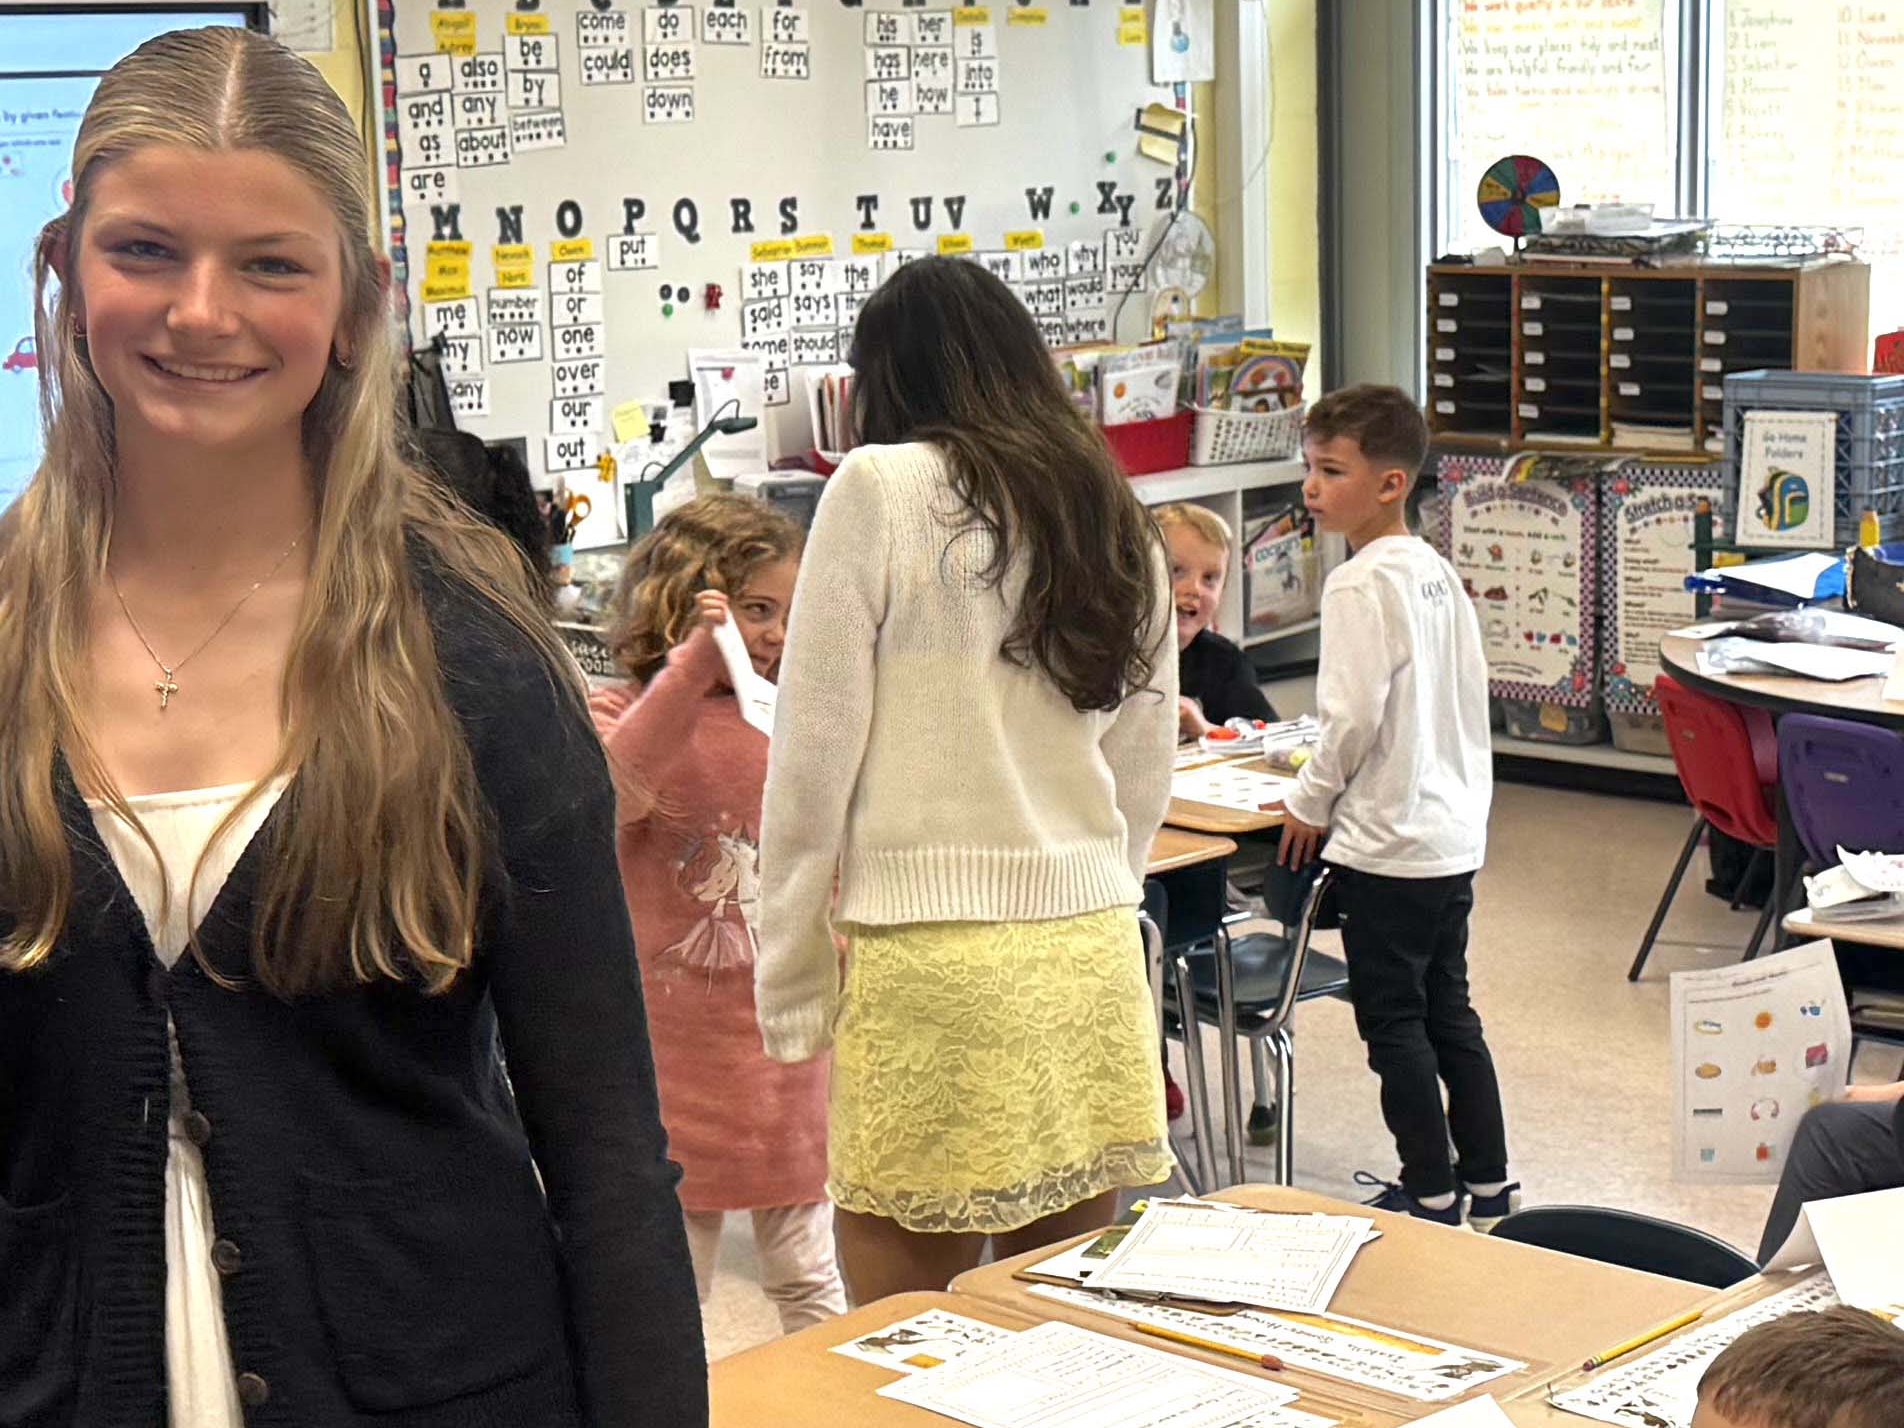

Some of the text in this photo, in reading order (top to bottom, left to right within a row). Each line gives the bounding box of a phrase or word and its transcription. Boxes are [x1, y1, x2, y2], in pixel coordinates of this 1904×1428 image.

[580, 14, 625, 31] come
[659, 11, 679, 29] do
[707, 9, 747, 30] each
[773, 11, 801, 31] for
[879, 14, 897, 33] his
[918, 14, 944, 33] her
[520, 38, 542, 58] be
[650, 48, 691, 68] does
[764, 47, 807, 67] from
[874, 48, 900, 68] has
[914, 47, 949, 67] here
[461, 56, 498, 77] also
[584, 52, 630, 71] could
[965, 63, 993, 81] into
[523, 74, 544, 98] by
[880, 83, 898, 103] he
[916, 83, 947, 103] how
[408, 98, 443, 119] and
[462, 95, 496, 123] any
[647, 90, 692, 110] down
[872, 117, 911, 138] have
[419, 134, 441, 152] as
[459, 131, 507, 153] about
[411, 172, 445, 191] are
[431, 178, 1172, 244] M N O P Q R S T U V W X Y Z
[619, 237, 645, 259] put
[800, 263, 824, 278] say
[1029, 252, 1060, 269] who
[566, 265, 586, 285] of
[751, 267, 778, 288] she
[845, 264, 869, 282] the
[1025, 284, 1060, 303] what
[1067, 277, 1103, 295] would
[437, 304, 466, 322] me
[490, 296, 538, 310] number
[566, 295, 586, 314] or
[750, 298, 782, 324] said
[794, 294, 831, 314] says
[496, 327, 533, 345] now
[562, 327, 594, 345] one
[794, 335, 835, 352] should
[556, 362, 599, 381] over
[562, 400, 591, 418] our
[556, 437, 585, 457] out
[1624, 495, 1671, 522] Stretch
